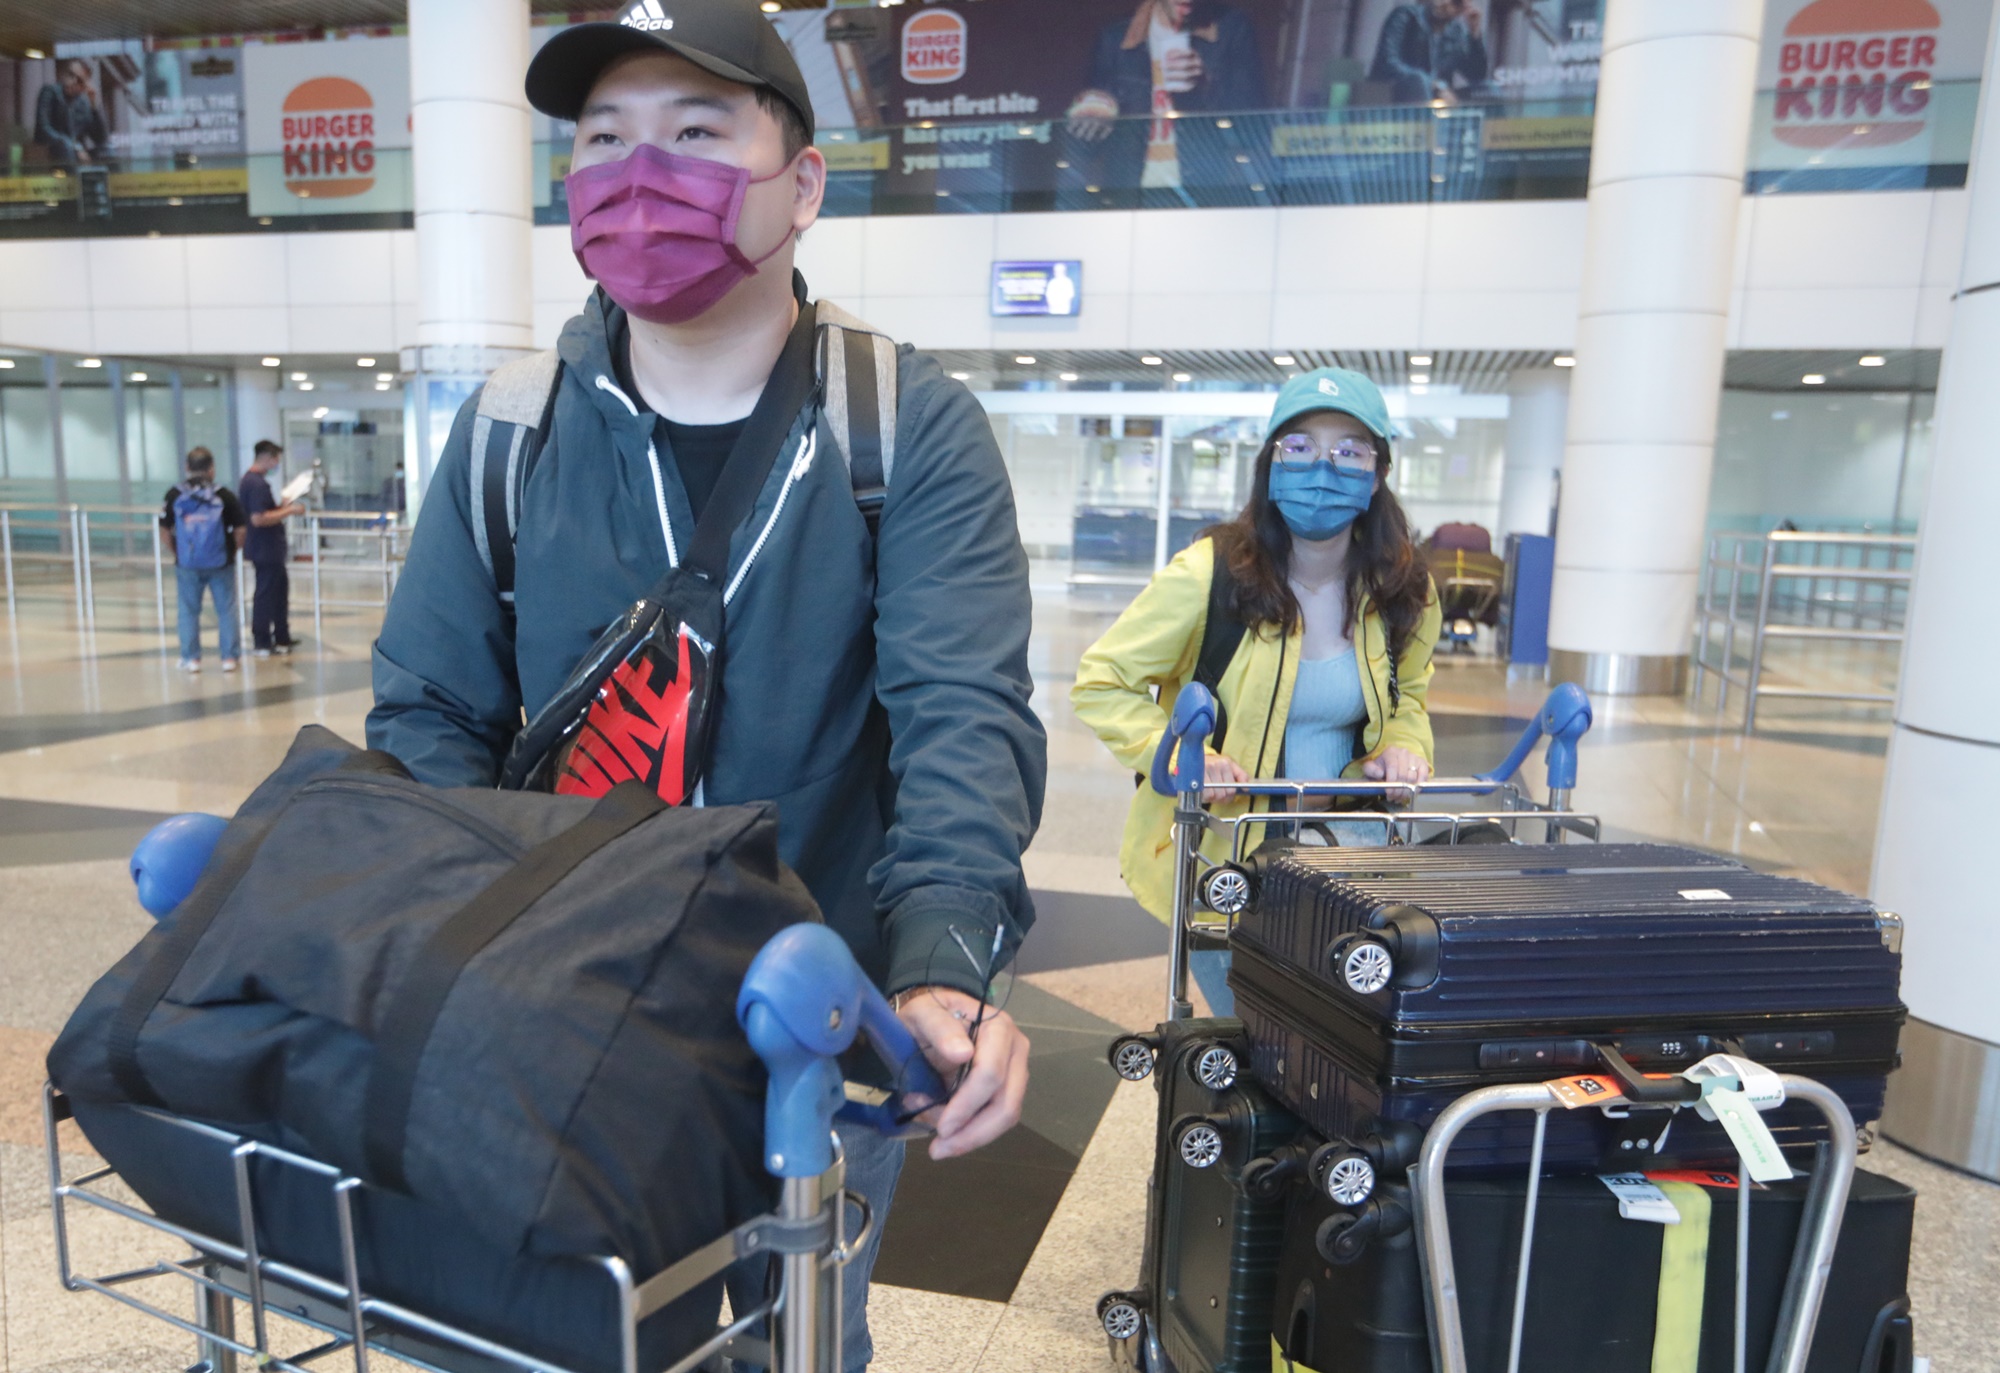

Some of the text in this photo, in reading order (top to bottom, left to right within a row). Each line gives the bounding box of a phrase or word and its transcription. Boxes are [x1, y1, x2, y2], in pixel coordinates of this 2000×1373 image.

[907, 34, 960, 47] BURGER
[907, 48, 960, 66] KING
[1779, 36, 1938, 73] BURGER
[904, 92, 1038, 118] That first bite
[1774, 71, 1933, 121] KING
[283, 114, 374, 141] BURGER
[903, 127, 938, 144] has
[284, 140, 375, 177] KING
[902, 152, 991, 175] you want
